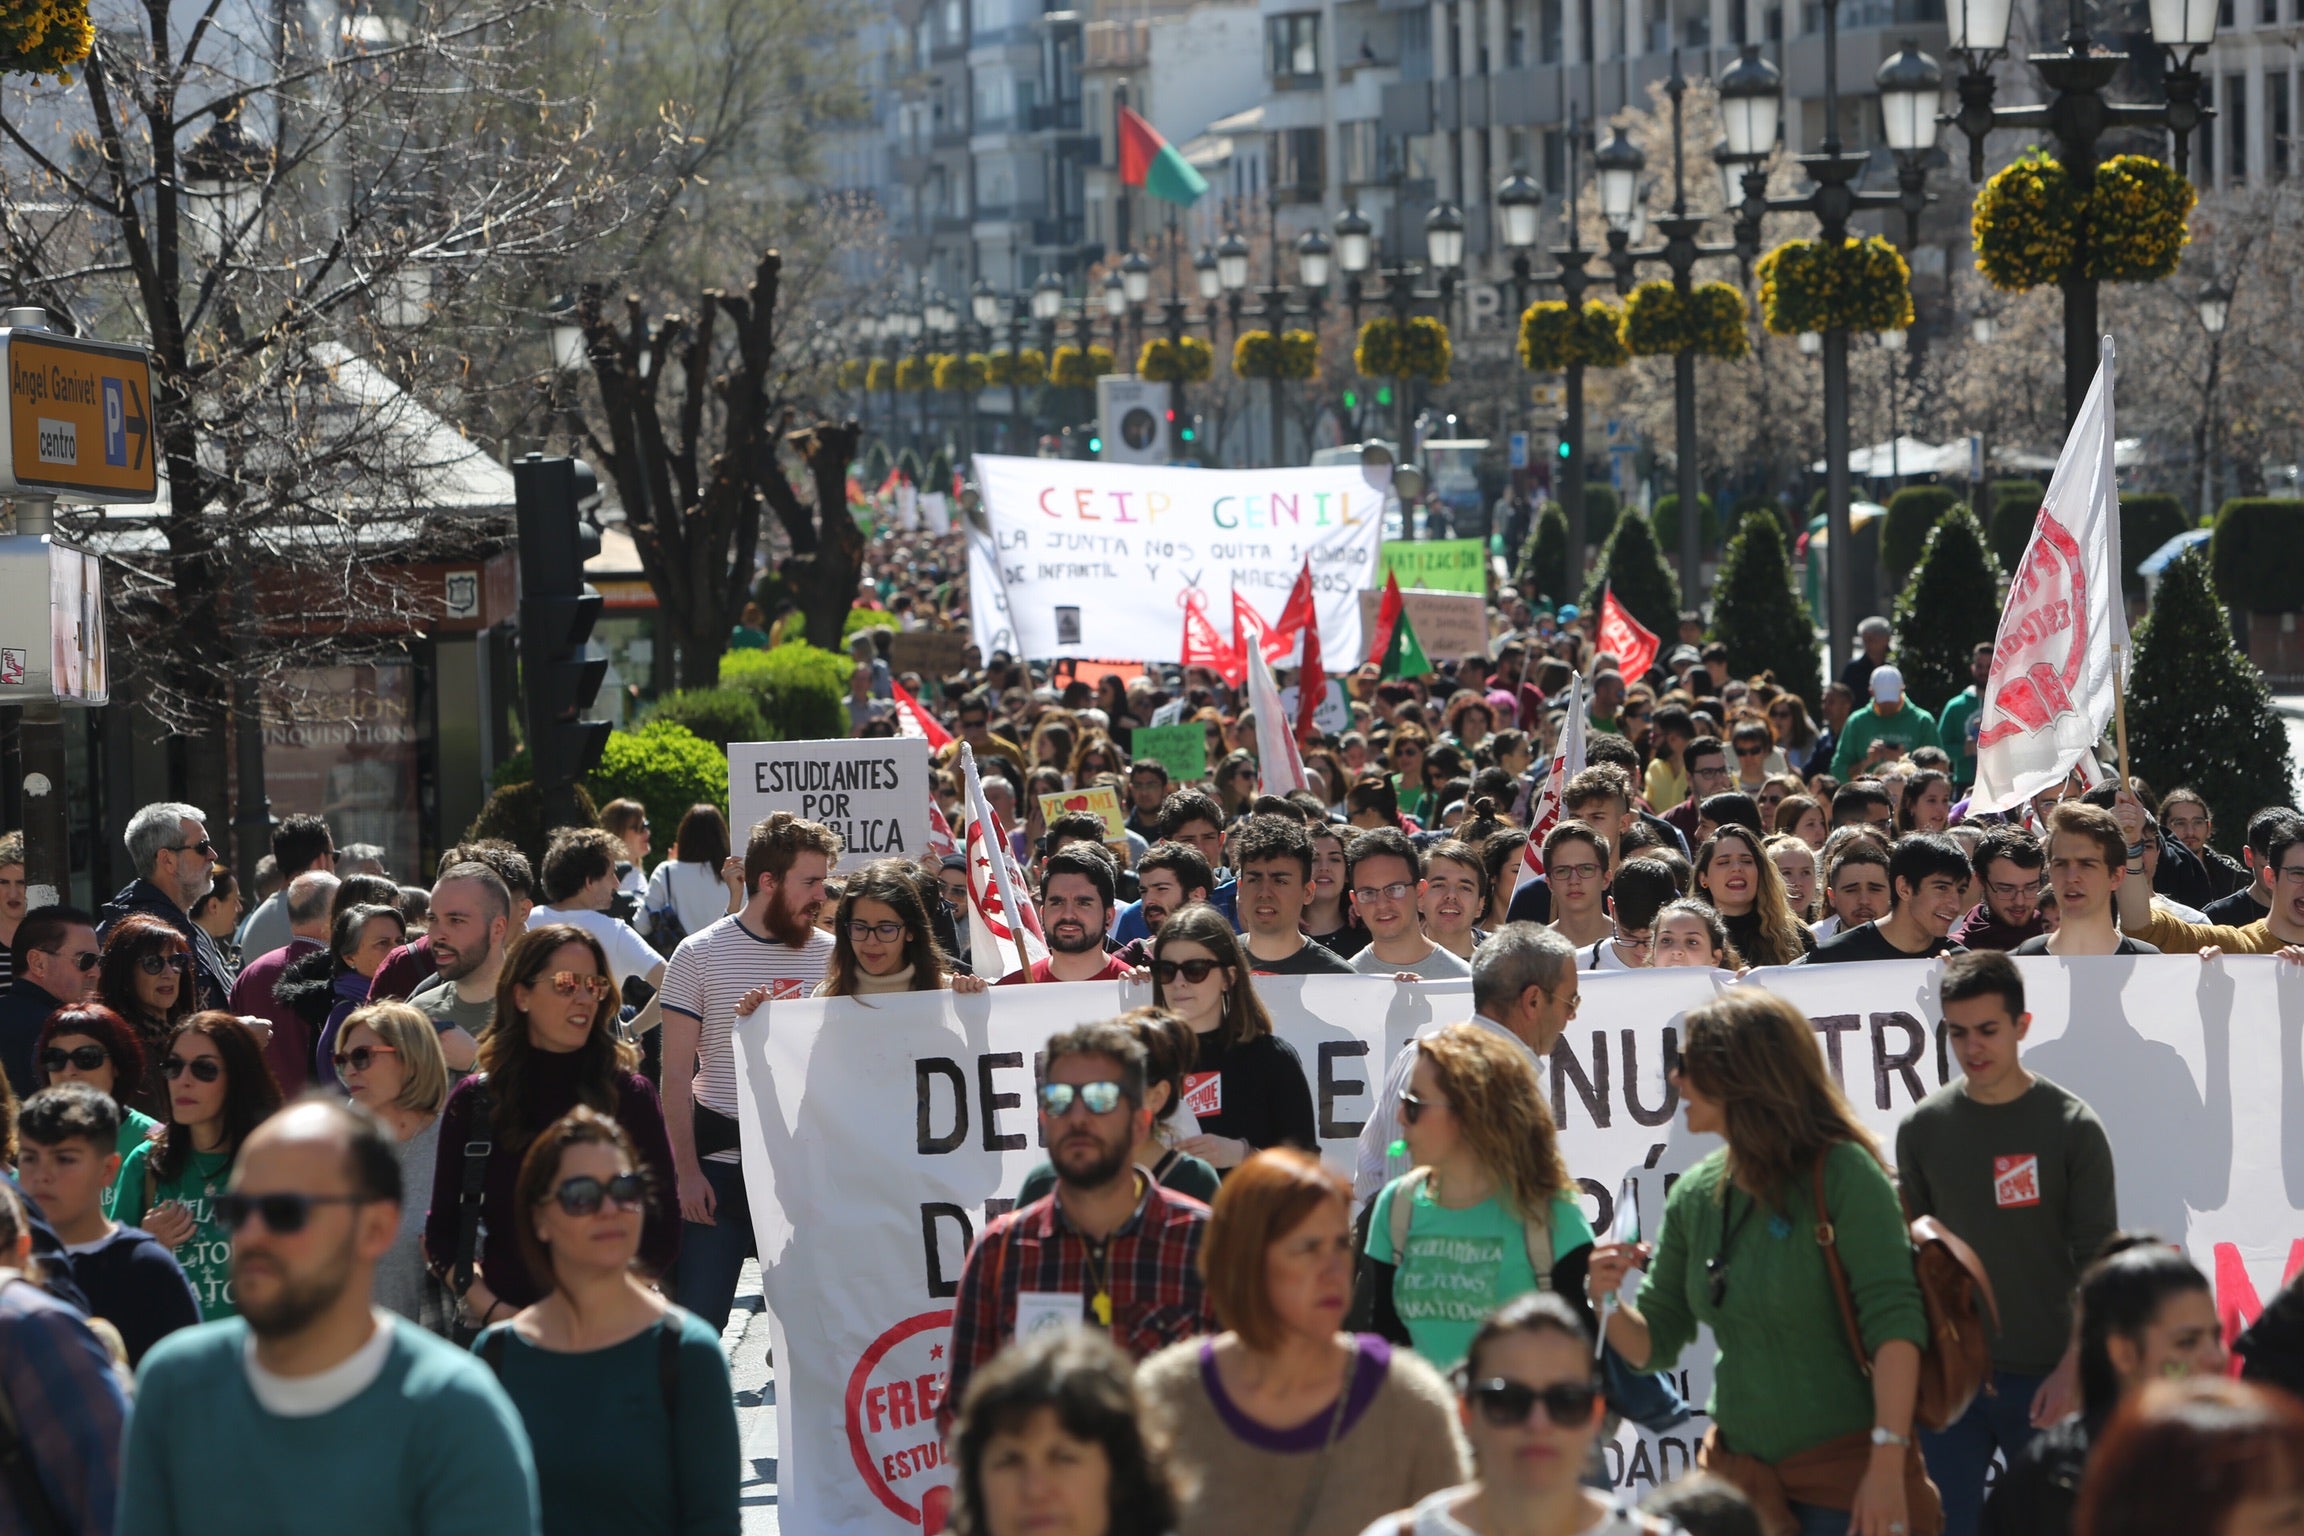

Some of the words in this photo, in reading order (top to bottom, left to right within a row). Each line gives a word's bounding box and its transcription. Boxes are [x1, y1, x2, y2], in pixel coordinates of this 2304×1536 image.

[14, 352, 48, 406] Ángel
[51, 365, 96, 406] Ganivet
[40, 427, 76, 460] centro
[1039, 487, 1171, 524] CEIP
[1213, 492, 1362, 529] GENIL
[998, 530, 1028, 551] LA
[1047, 531, 1129, 556] JUNTA
[1145, 540, 1195, 562] NOS
[1211, 543, 1272, 560] QUITA
[1005, 564, 1026, 585] DE
[1038, 562, 1118, 580] INFANTIL
[1145, 563, 1160, 582] Y
[1231, 568, 1353, 595] MAESROS
[755, 758, 899, 793] ESTUDIANTES
[802, 793, 851, 818] POR
